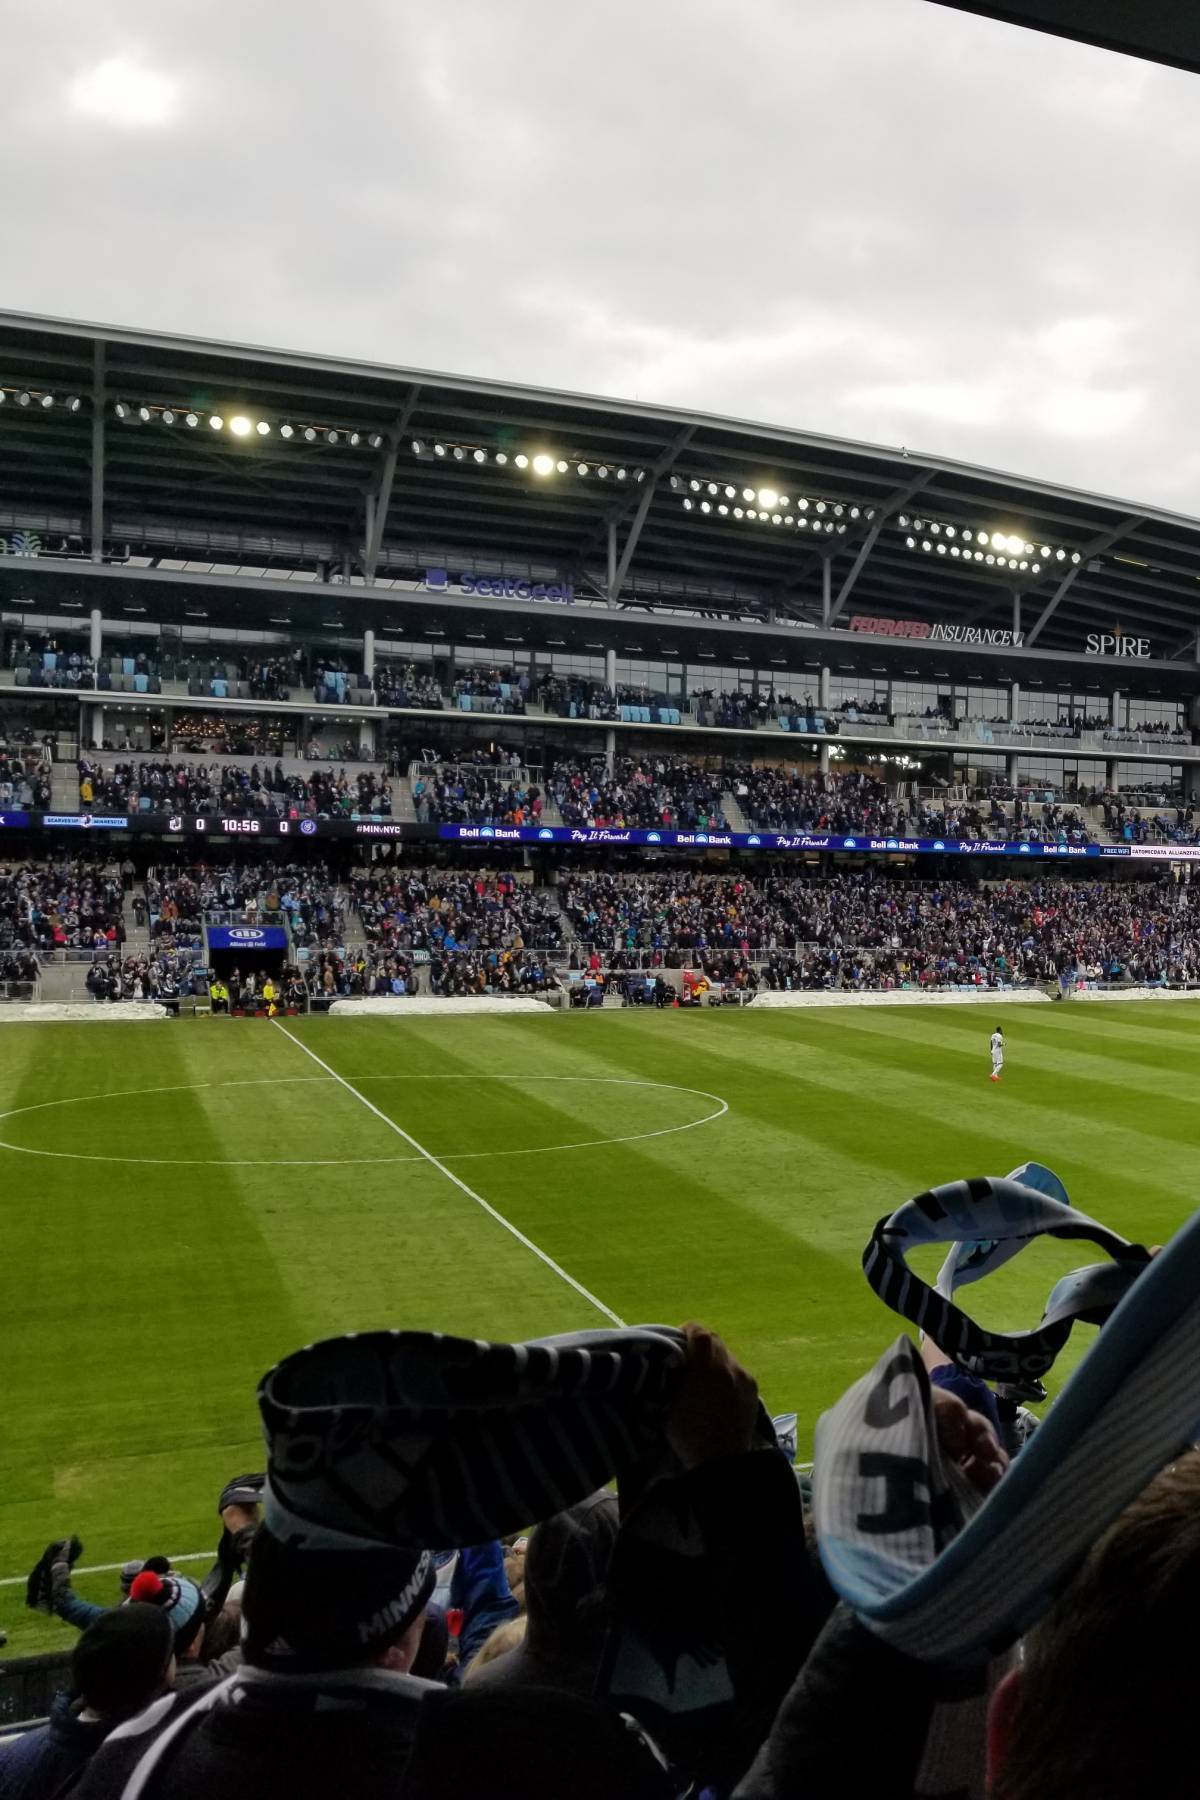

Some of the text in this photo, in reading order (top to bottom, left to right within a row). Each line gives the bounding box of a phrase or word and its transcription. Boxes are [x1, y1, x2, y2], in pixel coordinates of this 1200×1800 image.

[460, 572, 575, 604] SeatGeek
[850, 616, 1012, 646] FEDERATED INSURANCE
[1085, 634, 1151, 658] SPIRE
[195, 819, 205, 830] 0
[221, 819, 260, 832] 10:56
[279, 821, 288, 832] 0
[459, 828, 520, 838] Bell Bank
[571, 830, 587, 841] Pay
[599, 830, 630, 841] Forward
[677, 835, 731, 844] Bell Bank
[776, 836, 791, 846] Pay
[800, 837, 828, 847] Forward
[870, 841, 919, 849] Bell Bank
[1068, 846, 1087, 854] Bank
